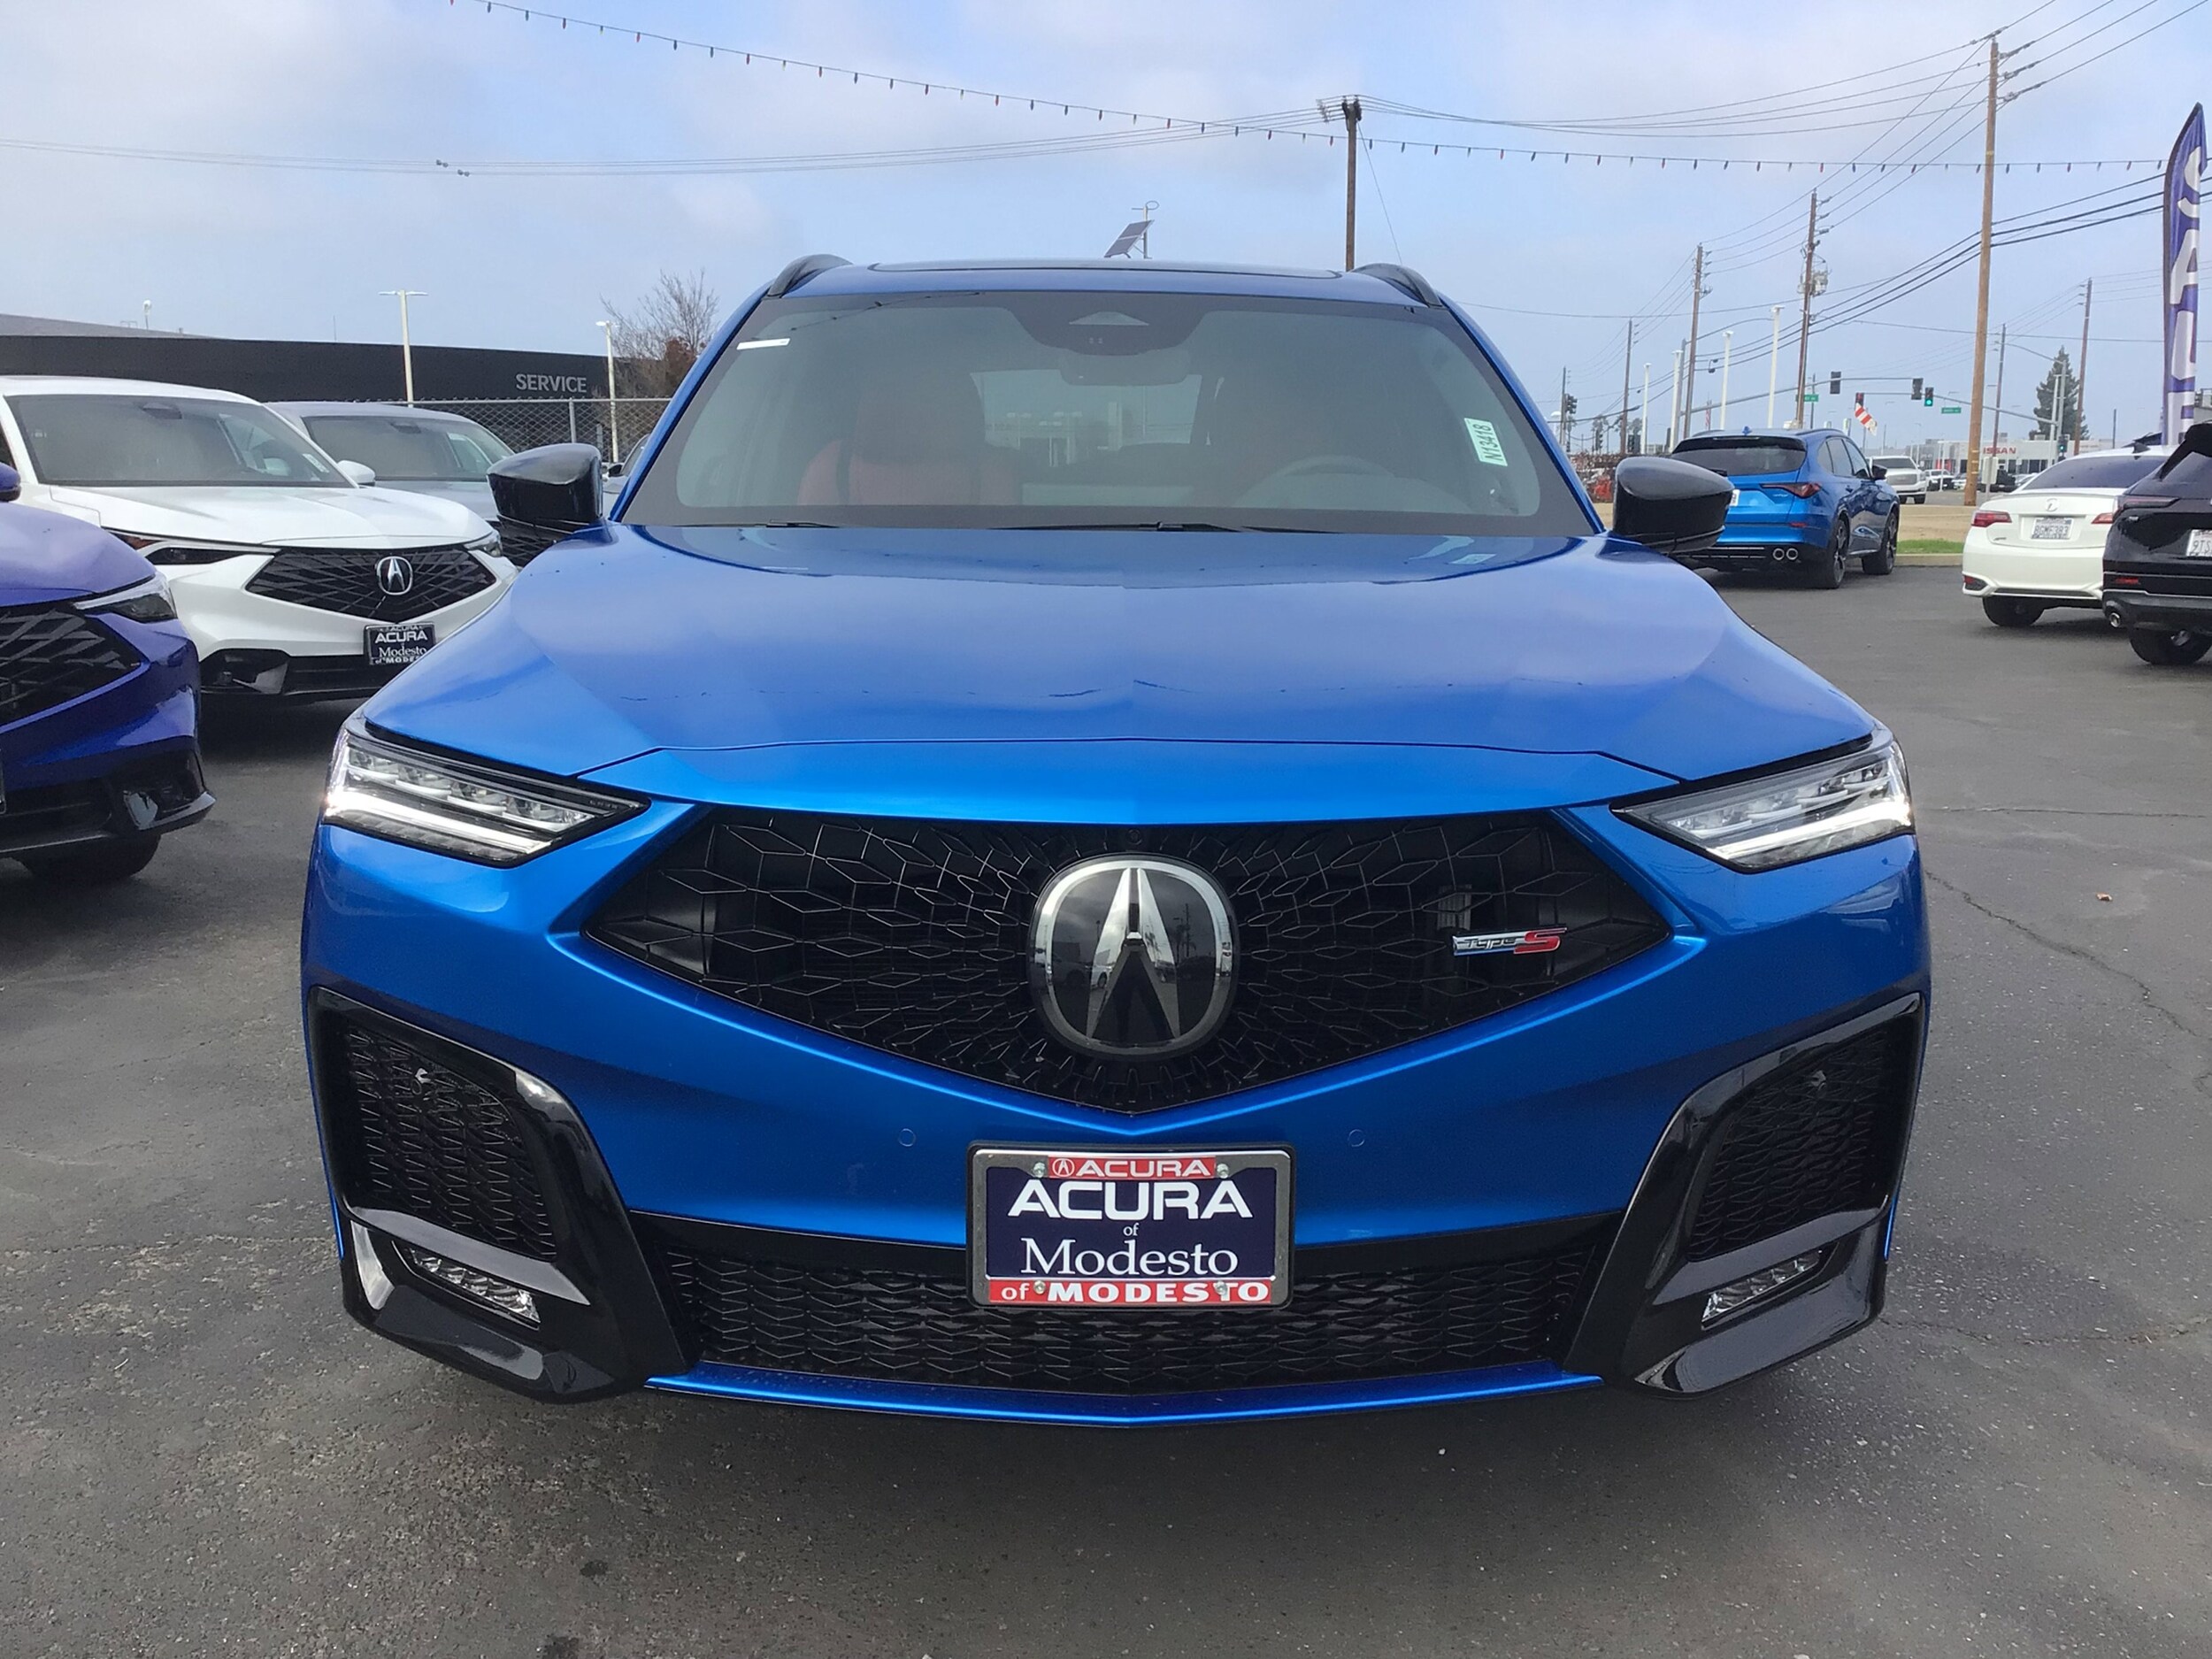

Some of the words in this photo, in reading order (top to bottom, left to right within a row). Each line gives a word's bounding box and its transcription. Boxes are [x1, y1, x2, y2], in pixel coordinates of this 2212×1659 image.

[516, 373, 587, 393] SERVICE
[1472, 424, 1504, 461] N13418
[375, 630, 428, 643] ACURA
[379, 645, 426, 657] Modesto
[1514, 927, 1568, 954] S
[1076, 1159, 1211, 1178] ACURA
[1008, 1179, 1253, 1220] ACURA
[1123, 1222, 1139, 1236] of
[1020, 1238, 1238, 1275] Modesto
[1002, 1283, 1029, 1301] of
[1047, 1282, 1269, 1302] MODESTO
